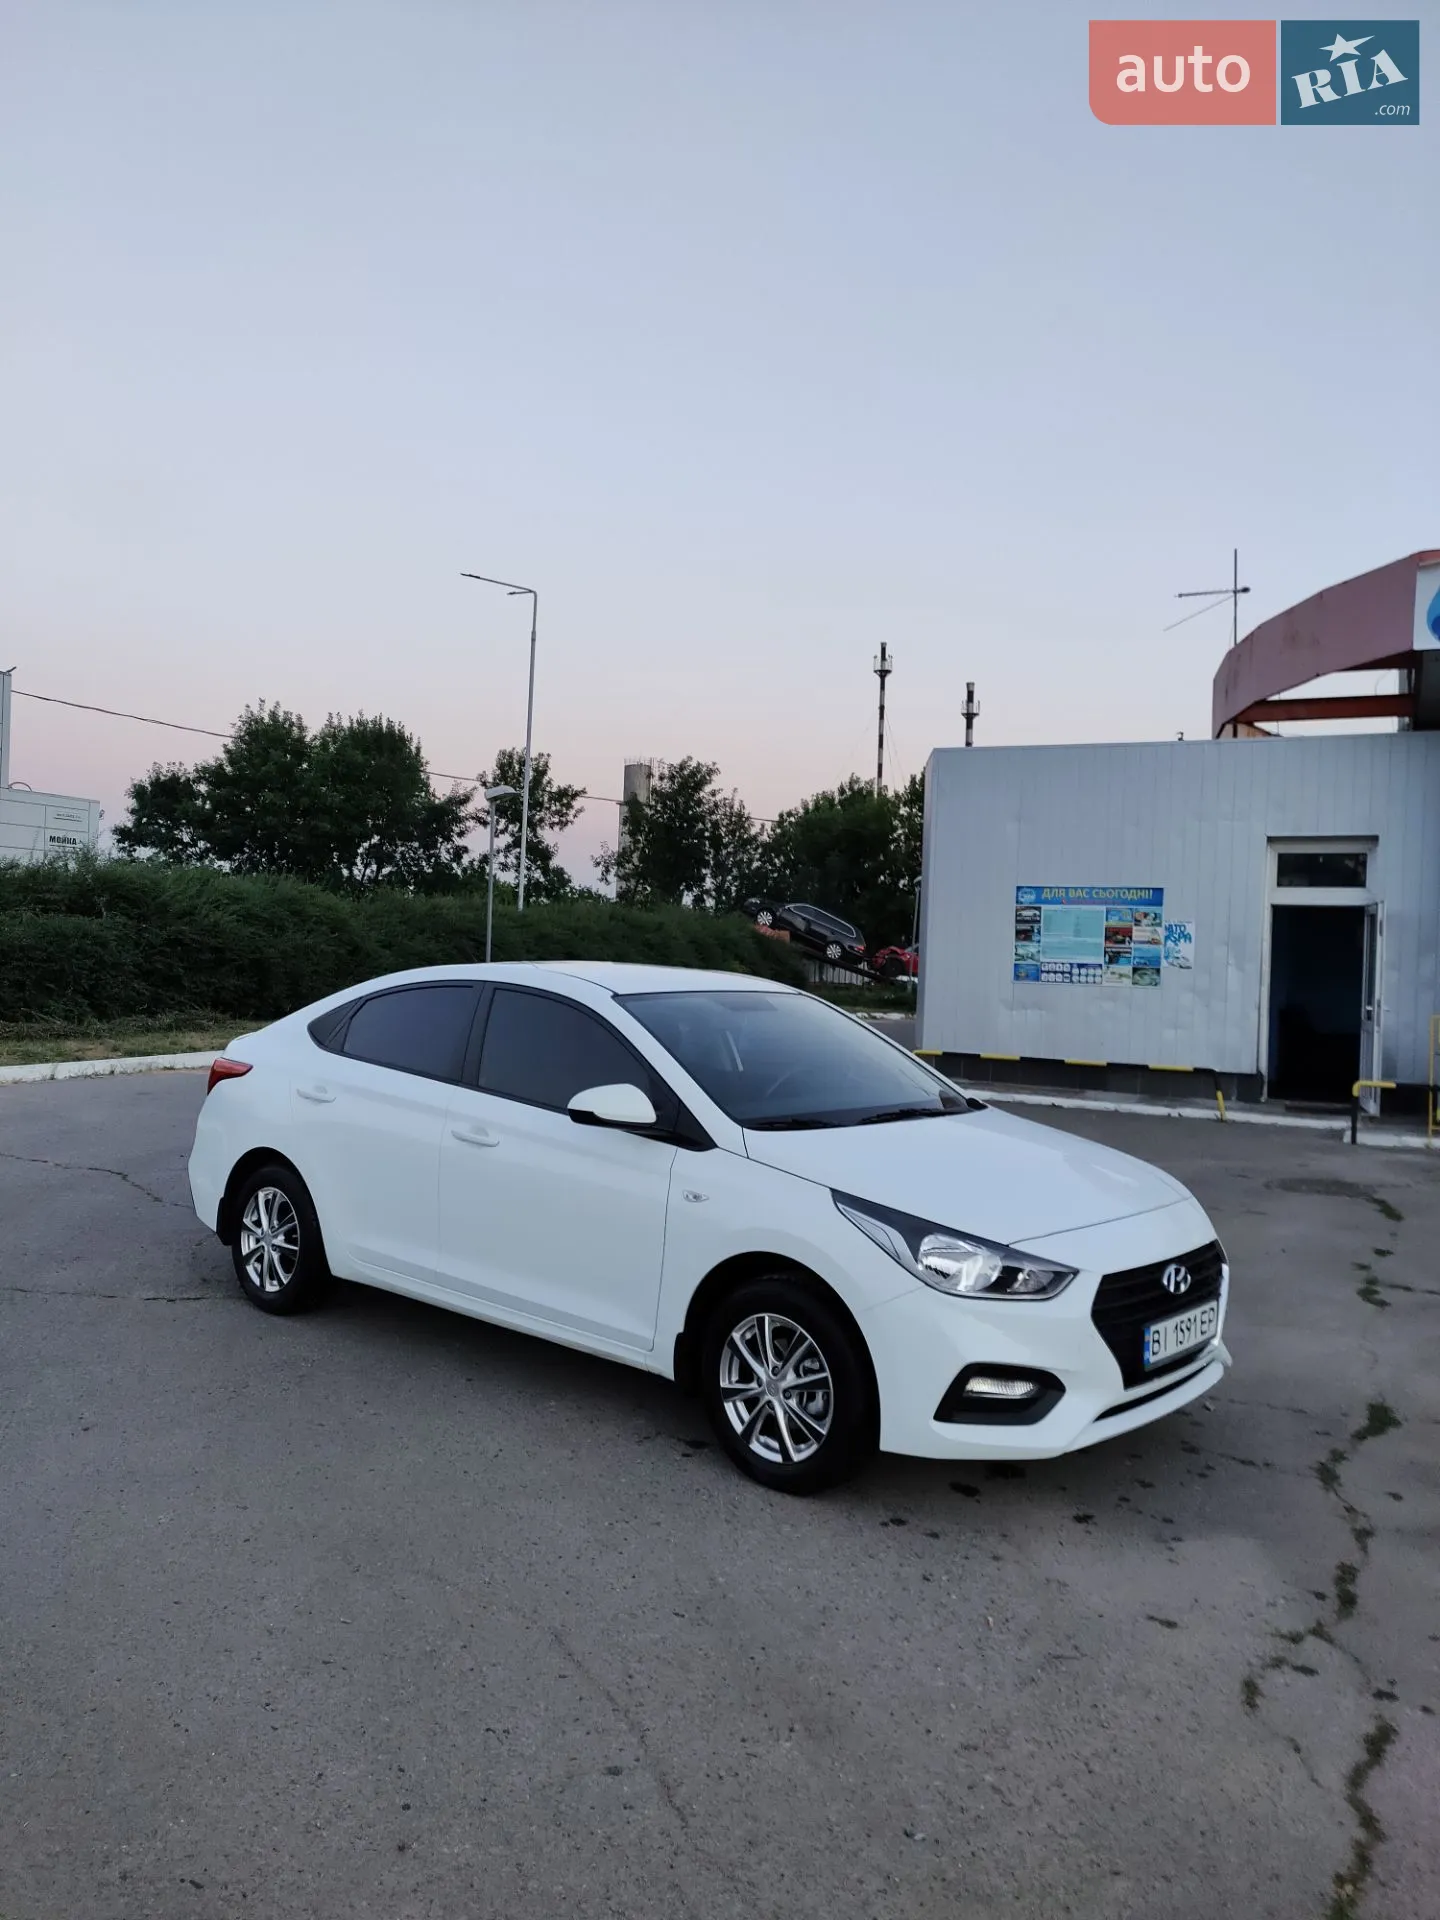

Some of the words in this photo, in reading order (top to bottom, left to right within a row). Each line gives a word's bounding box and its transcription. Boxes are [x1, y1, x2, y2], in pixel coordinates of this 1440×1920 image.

[1042, 888, 1066, 900] ДЛЯ
[1068, 888, 1090, 899] ВАС
[1152, 1326, 1167, 1356] BI
[1173, 1314, 1198, 1348] 1591
[1200, 1307, 1216, 1336] EP
